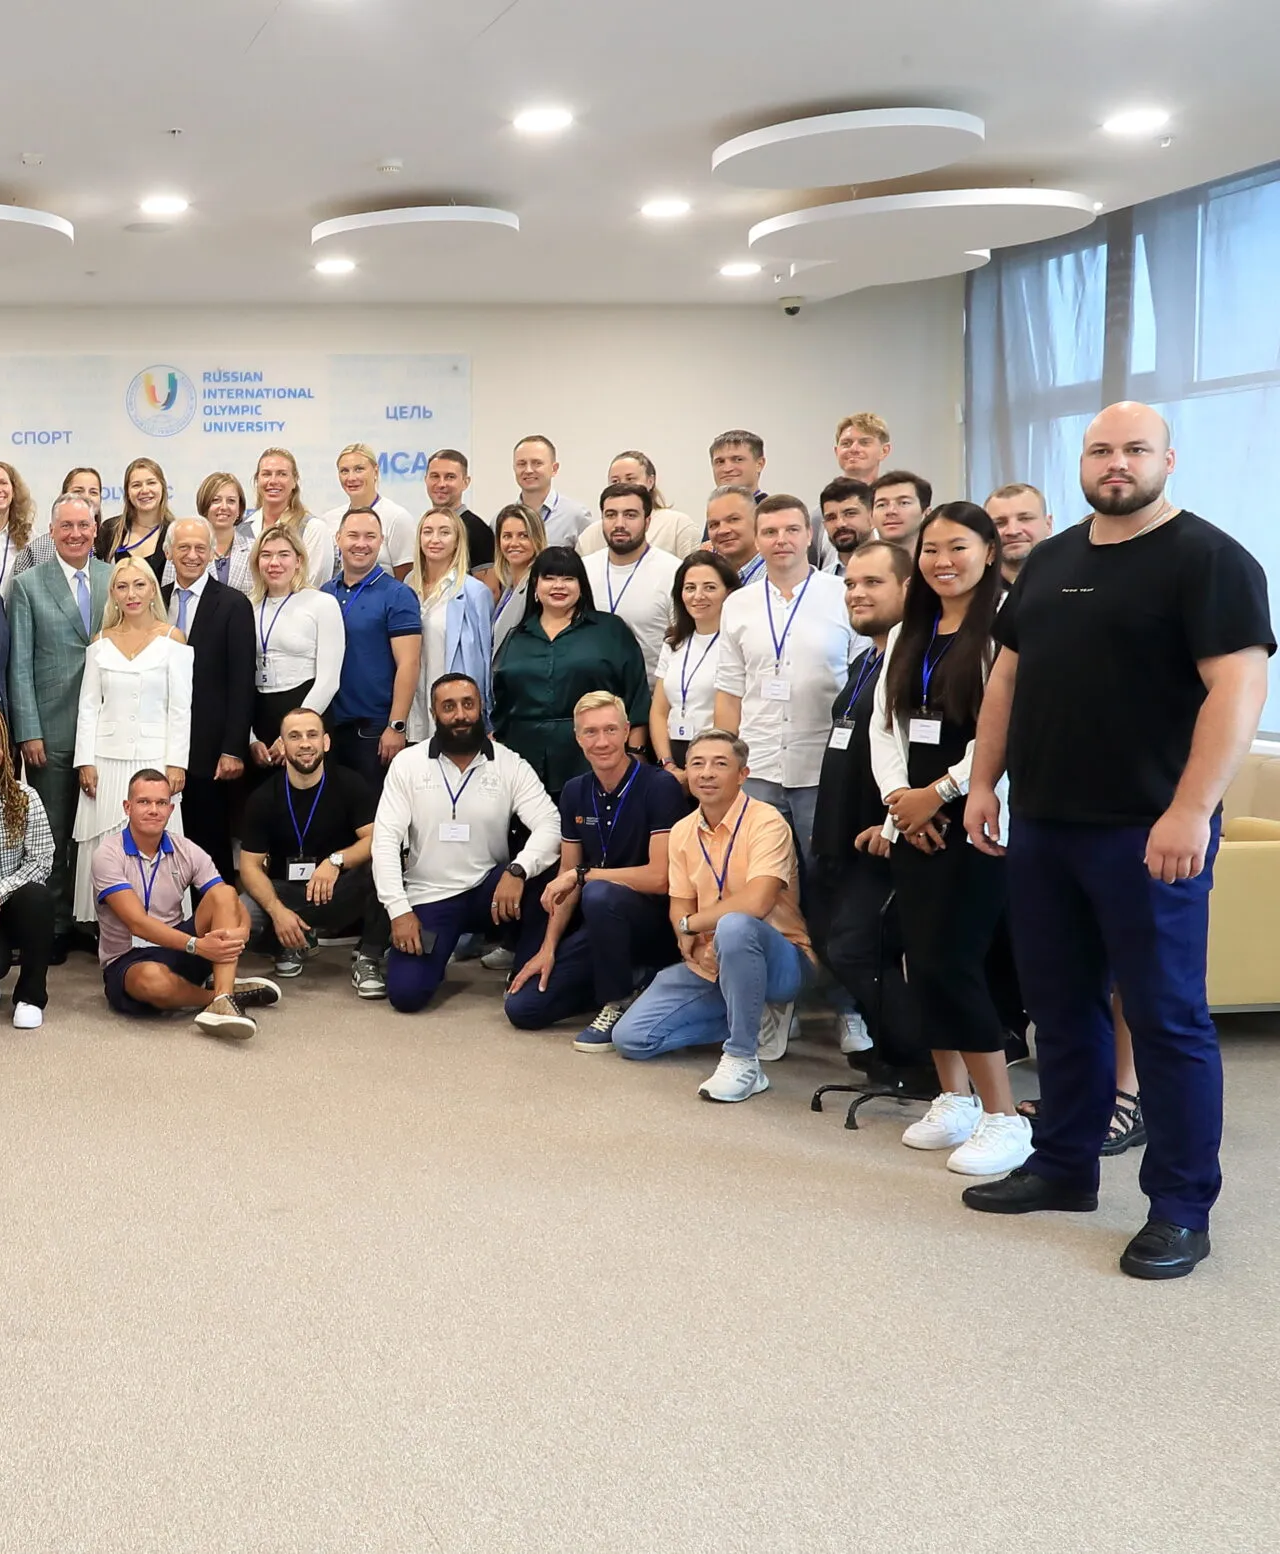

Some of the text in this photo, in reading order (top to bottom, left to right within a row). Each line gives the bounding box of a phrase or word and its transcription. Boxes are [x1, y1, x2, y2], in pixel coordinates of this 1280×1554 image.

[202, 371, 263, 383] RUSSIAN
[202, 388, 314, 399] INTERNATIONAL
[203, 405, 262, 416] OLYMPIC
[386, 405, 433, 421] ЦЕЛЬ
[203, 421, 285, 433] UNIVERSITY
[11, 431, 73, 445] СПОРТ
[679, 726, 685, 736] 6
[299, 867, 306, 876] 7
